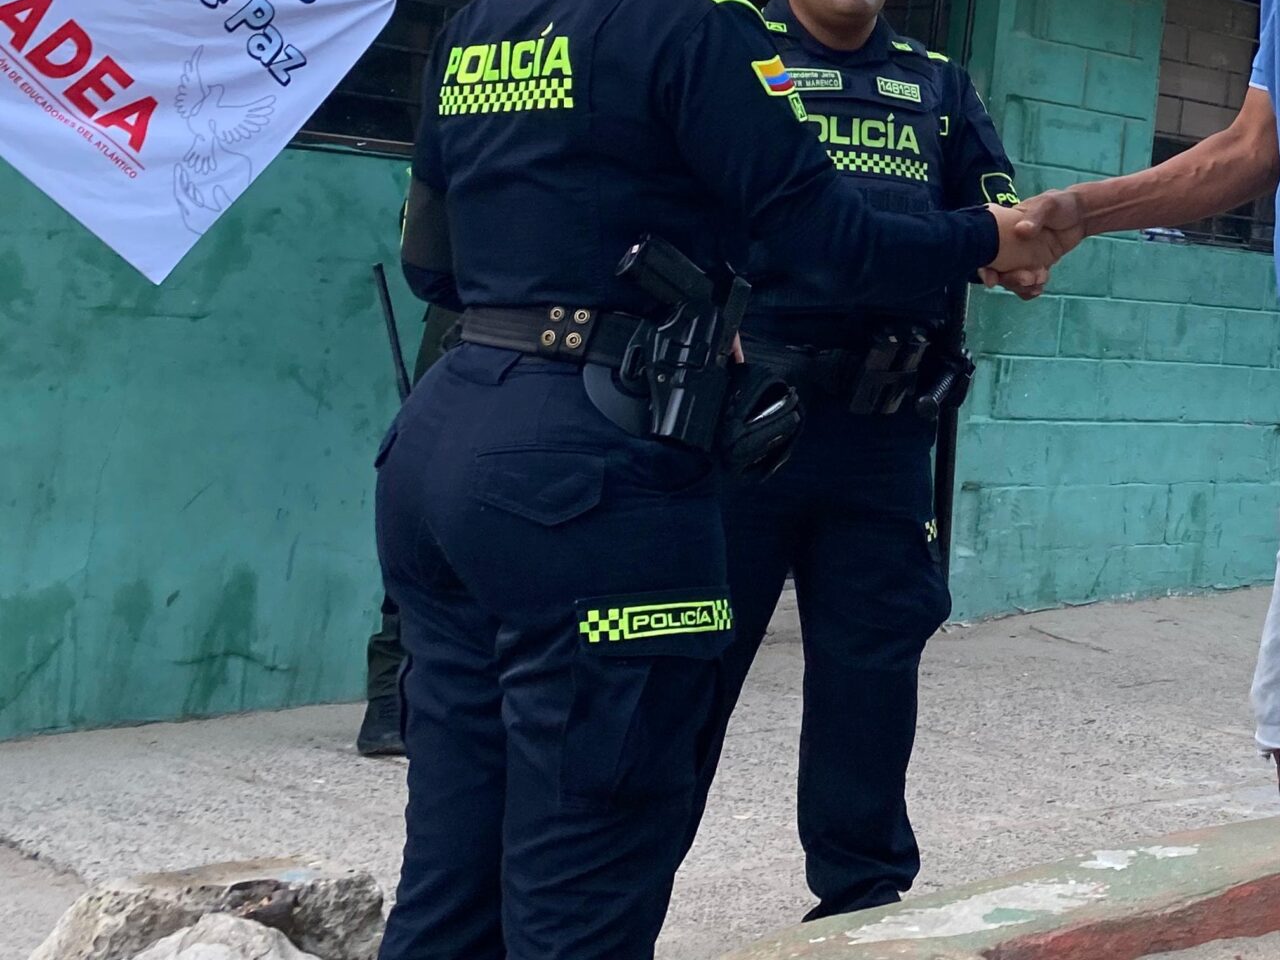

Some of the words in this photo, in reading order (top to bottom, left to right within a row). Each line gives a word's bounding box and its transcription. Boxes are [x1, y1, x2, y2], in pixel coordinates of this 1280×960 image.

[443, 21, 572, 85] POLICÍA
[8, 70, 23, 83] DE
[20, 82, 76, 129] EDUCADORES
[76, 126, 93, 143] DEL
[880, 81, 918, 98] 148128
[806, 112, 921, 155] OLICÍA
[632, 606, 712, 631] POLICÍA
